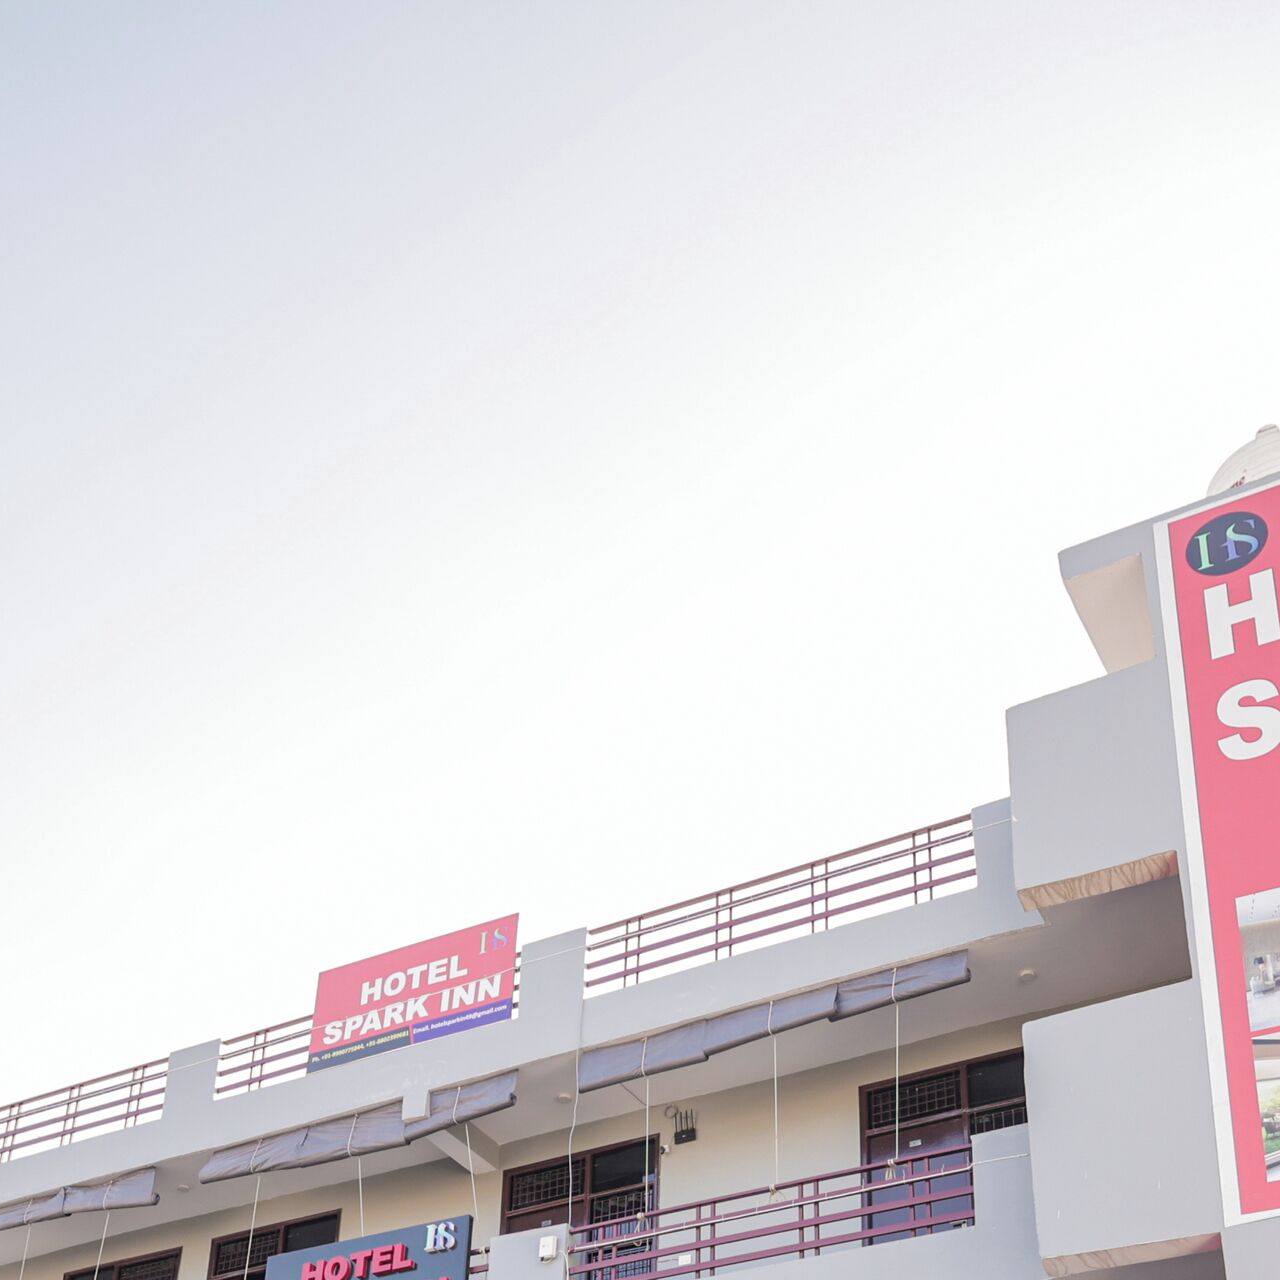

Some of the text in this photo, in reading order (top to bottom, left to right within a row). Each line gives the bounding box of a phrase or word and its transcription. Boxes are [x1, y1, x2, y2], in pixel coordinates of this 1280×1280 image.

[322, 973, 503, 1046] SPARK INN
[360, 955, 468, 1005] HOTEL
